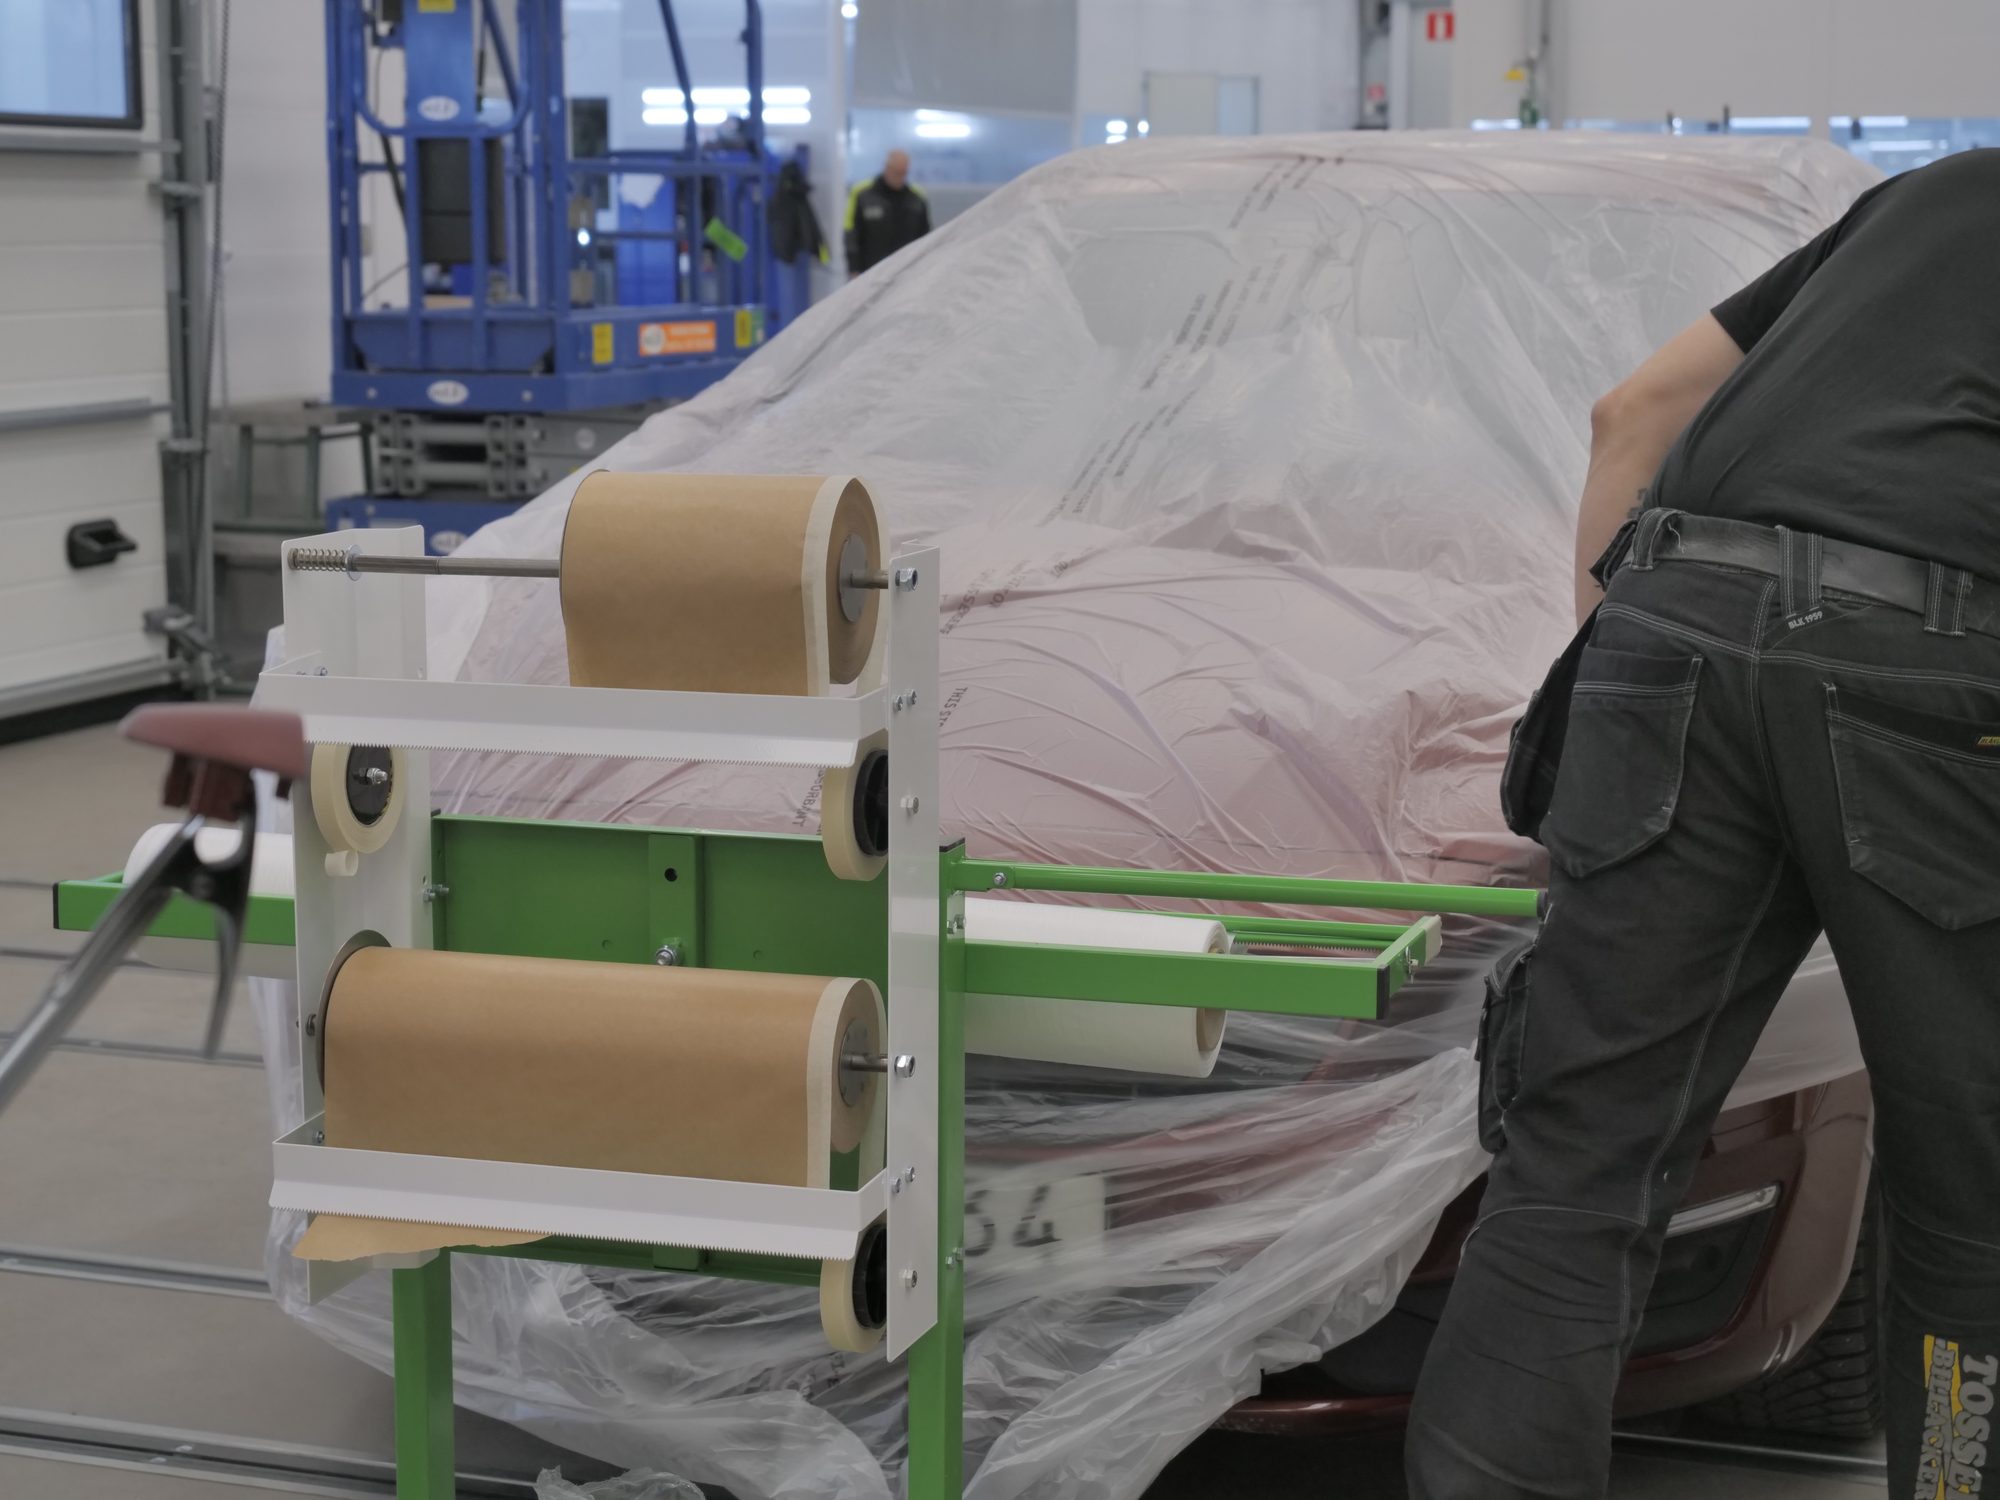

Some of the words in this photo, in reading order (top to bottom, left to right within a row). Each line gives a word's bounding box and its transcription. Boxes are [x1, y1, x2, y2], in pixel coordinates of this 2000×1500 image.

[1788, 617, 1805, 630] BLK
[1805, 611, 1823, 623] 1959
[944, 687, 968, 708] THIS
